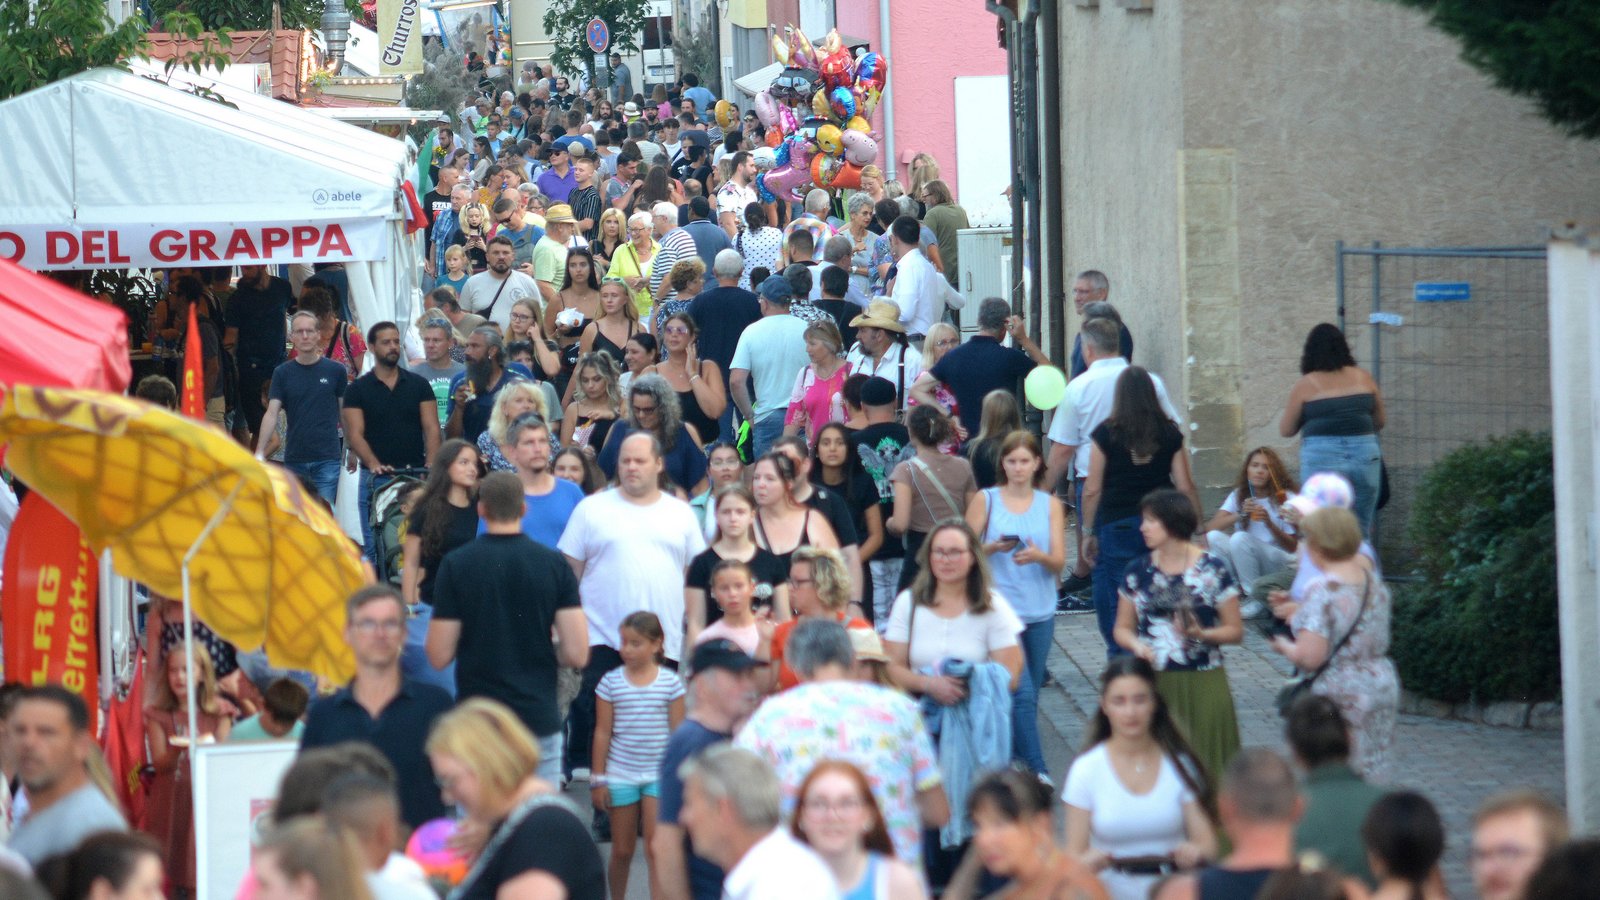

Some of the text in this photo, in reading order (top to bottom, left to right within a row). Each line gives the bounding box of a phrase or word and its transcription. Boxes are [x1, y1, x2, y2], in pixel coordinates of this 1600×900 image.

[382, 0, 417, 66] Churros
[331, 191, 362, 201] abele
[46, 230, 131, 264] DEL
[149, 223, 353, 263] GRAPPA
